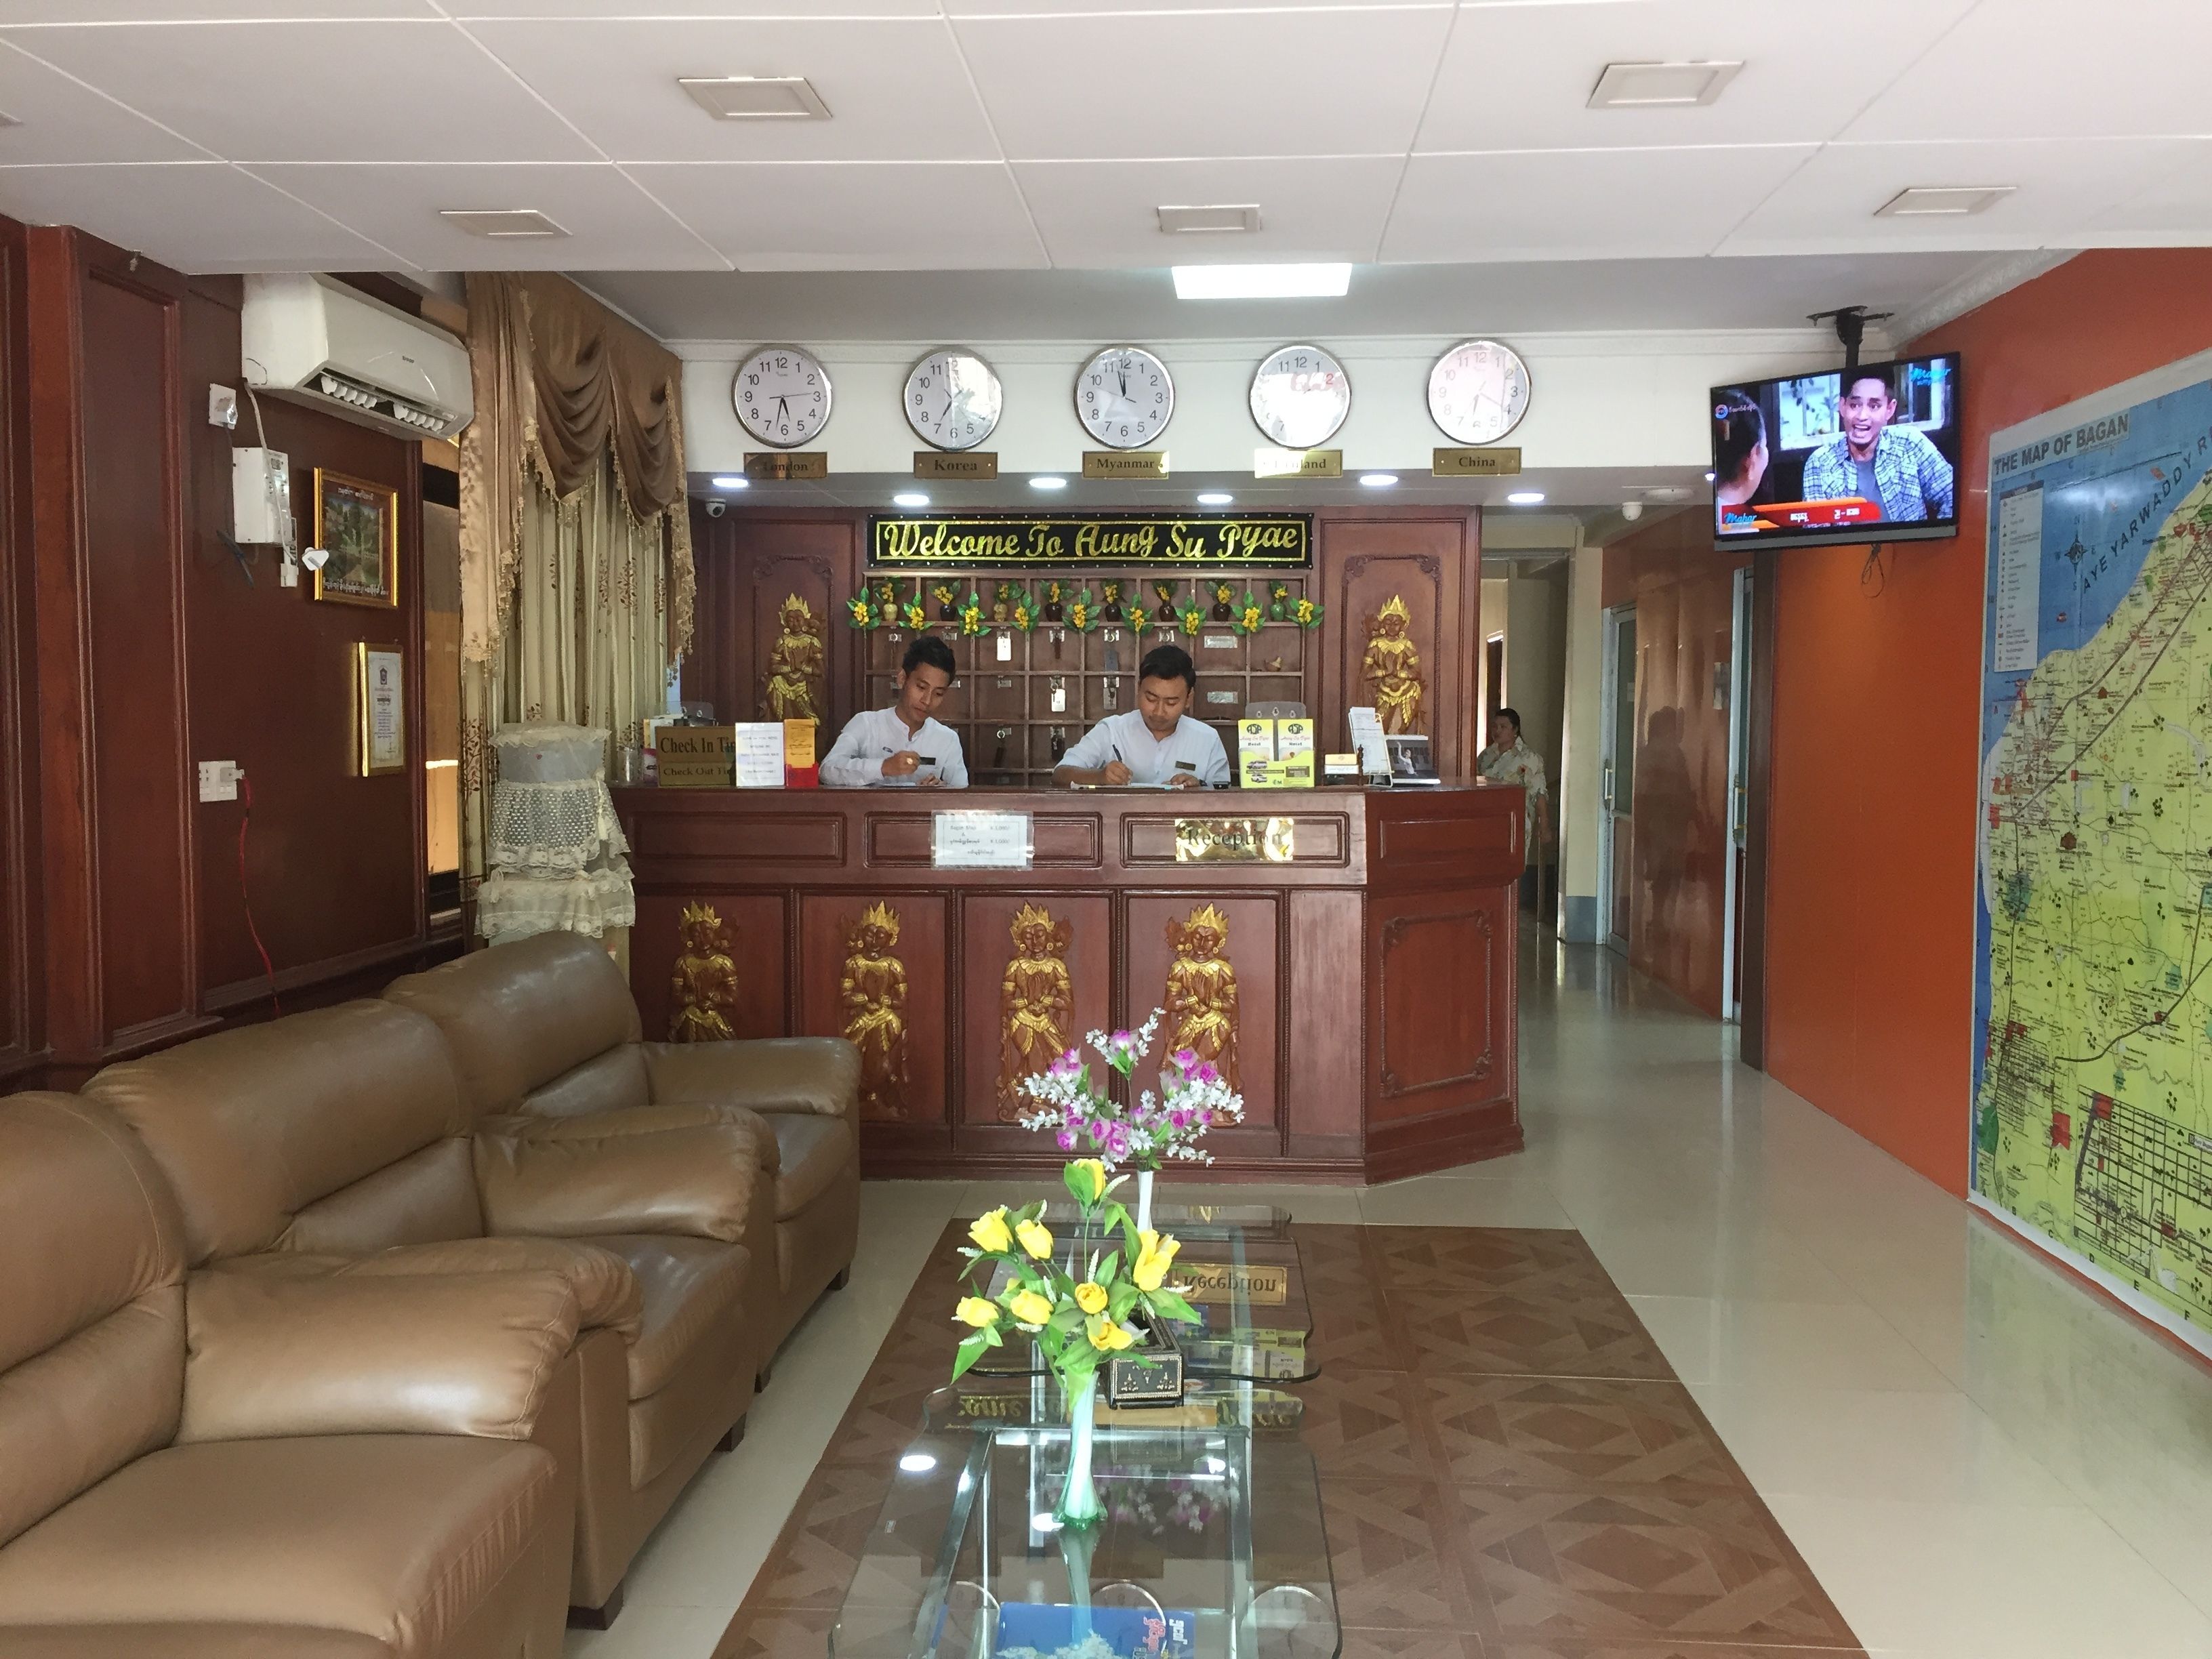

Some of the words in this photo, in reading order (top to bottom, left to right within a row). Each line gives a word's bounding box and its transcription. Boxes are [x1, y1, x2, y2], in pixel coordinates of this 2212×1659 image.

[775, 357, 787, 369] 12
[1294, 356, 1307, 368] 12
[1458, 356, 1469, 367] 11
[1474, 352, 1487, 363] 12
[1495, 356, 1500, 367] 1
[760, 361, 771, 372] 11
[796, 362, 800, 373] 1
[1103, 362, 1113, 373] 11
[1119, 358, 1131, 369] 12
[1139, 363, 1144, 373] 1
[1279, 361, 1289, 372] 11
[1315, 361, 1320, 373] 1
[930, 365, 941, 375] 11
[1445, 369, 1456, 381] 10
[1505, 369, 1514, 380] 2
[748, 374, 759, 385] 10
[807, 374, 815, 385] 2
[919, 377, 930, 388] 10
[1091, 375, 1102, 386] 10
[1150, 375, 1158, 386] 2
[1326, 373, 1334, 385] 2
[745, 391, 752, 402] 9
[813, 391, 821, 402] 3
[1439, 386, 1447, 398] 9
[1511, 386, 1518, 397] 3
[916, 394, 923, 405] 9
[1086, 392, 1094, 403] 9
[1155, 392, 1163, 403] 3
[752, 408, 759, 419] 8
[808, 409, 816, 419] 4
[921, 411, 928, 422] 8
[1092, 409, 1099, 420] 8
[1149, 410, 1158, 420] 4
[764, 420, 771, 431] 7
[781, 424, 788, 435] 6
[797, 421, 804, 431] 5
[934, 424, 941, 434] 7
[966, 424, 975, 434] 5
[1105, 421, 1112, 432] 7
[1137, 422, 1145, 433] 5
[950, 428, 958, 438] 6
[1121, 426, 1128, 437] 6
[1994, 453, 2018, 474] THE
[2022, 442, 2049, 466] MAP
[2053, 434, 2072, 455] OF
[2076, 413, 2129, 448] BAGAN
[763, 461, 808, 472] London
[935, 459, 977, 471] Korea
[1097, 458, 1154, 472] Myanmar
[1458, 456, 1496, 468] China
[884, 524, 1020, 556] Welcome
[1025, 525, 1064, 557] To
[1076, 524, 1158, 557] Aung
[1166, 523, 1206, 558] Su
[1216, 523, 1297, 558] Pyae
[660, 737, 698, 753] Check
[701, 737, 714, 753] In
[695, 767, 714, 775] Out
[1188, 829, 1282, 851] Reception
[2134, 1279, 2139, 1291] E
[2185, 1309, 2190, 1320] F
